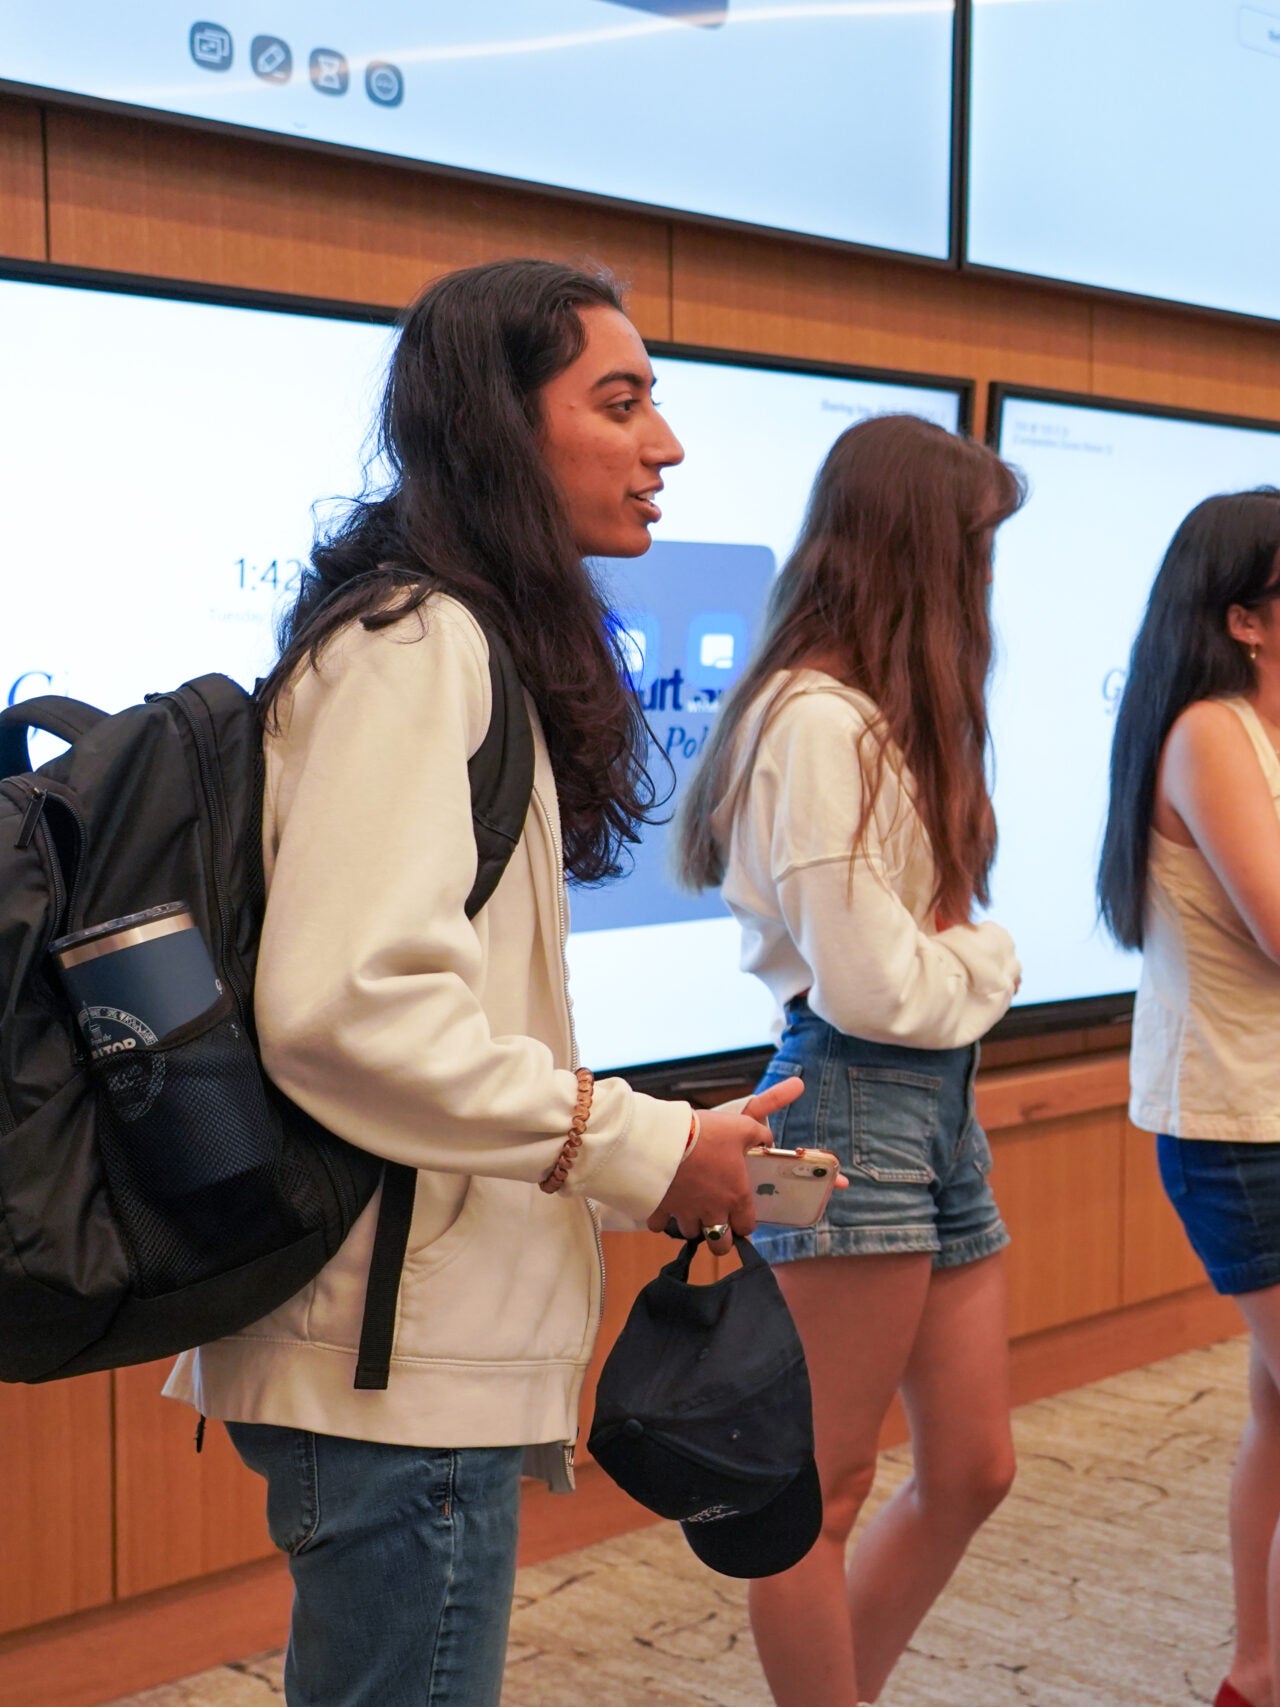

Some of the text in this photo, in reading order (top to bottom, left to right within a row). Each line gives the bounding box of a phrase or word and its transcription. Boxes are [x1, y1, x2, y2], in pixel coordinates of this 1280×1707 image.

[233, 557, 302, 591] 1:42
[640, 668, 684, 711] urt
[665, 725, 709, 759] Pol
